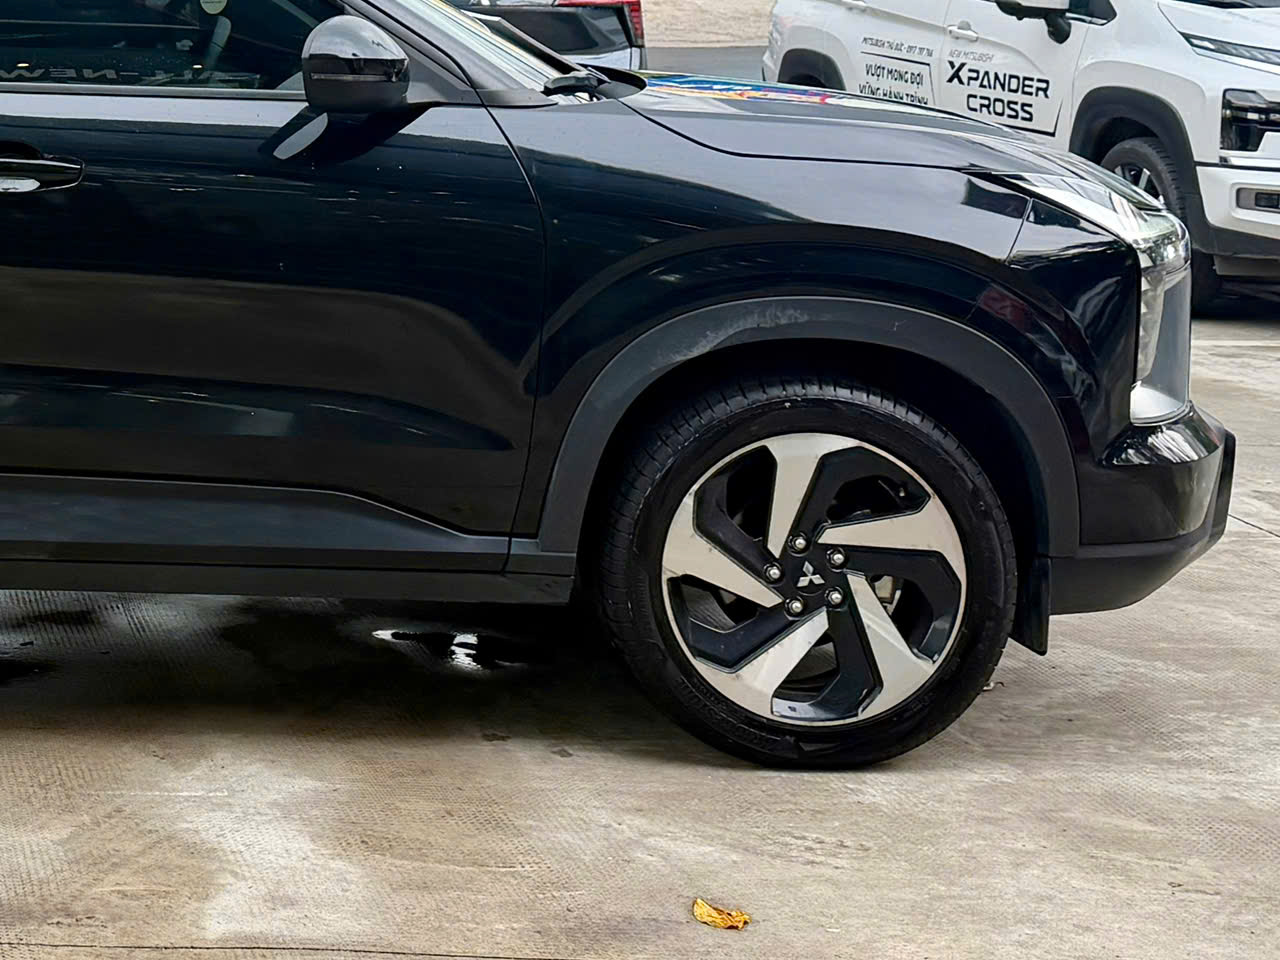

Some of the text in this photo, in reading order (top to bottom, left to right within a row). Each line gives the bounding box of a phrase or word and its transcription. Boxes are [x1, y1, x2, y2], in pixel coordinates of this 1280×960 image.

[887, 68, 909, 83] MONG
[946, 60, 1050, 99] XPANDER
[966, 93, 1034, 122] CROSS
